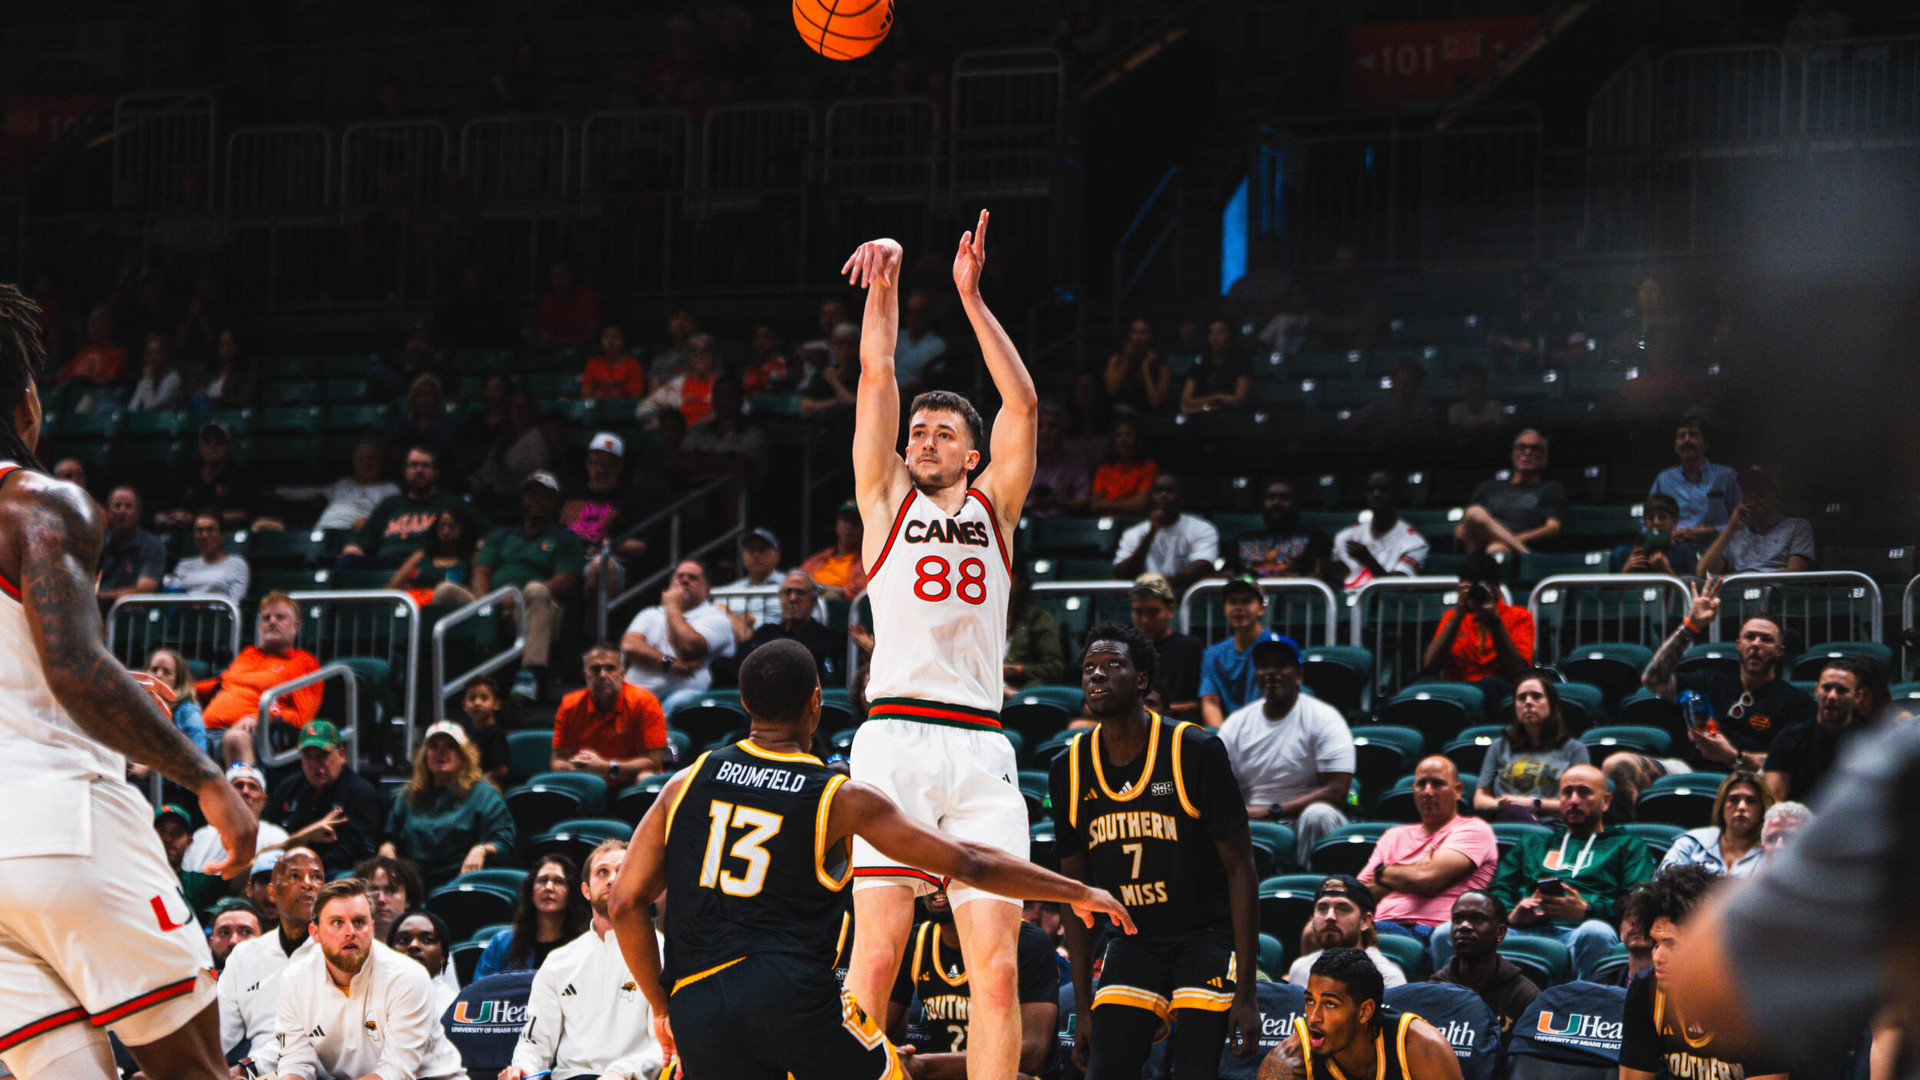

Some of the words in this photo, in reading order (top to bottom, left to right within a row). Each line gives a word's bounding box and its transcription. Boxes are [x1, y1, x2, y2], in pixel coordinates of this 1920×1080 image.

[1382, 43, 1434, 75] 101
[904, 518, 989, 548] CANES
[913, 555, 987, 606] 88
[715, 761, 807, 793] BRUMFIELD
[1151, 781, 1174, 796] SBC
[1088, 811, 1178, 850] SOUTHERN
[699, 799, 784, 898] 13
[1122, 843, 1143, 880] 7
[1119, 881, 1168, 906] MISS
[923, 994, 971, 1021] OUTH
[451, 1026, 483, 1034] UNIVERSITY
[946, 1024, 968, 1053] 2
[1535, 1035, 1569, 1044] UNIVERSITY
[1570, 1038, 1579, 1046] OF
[1580, 1040, 1602, 1048] MIAMI
